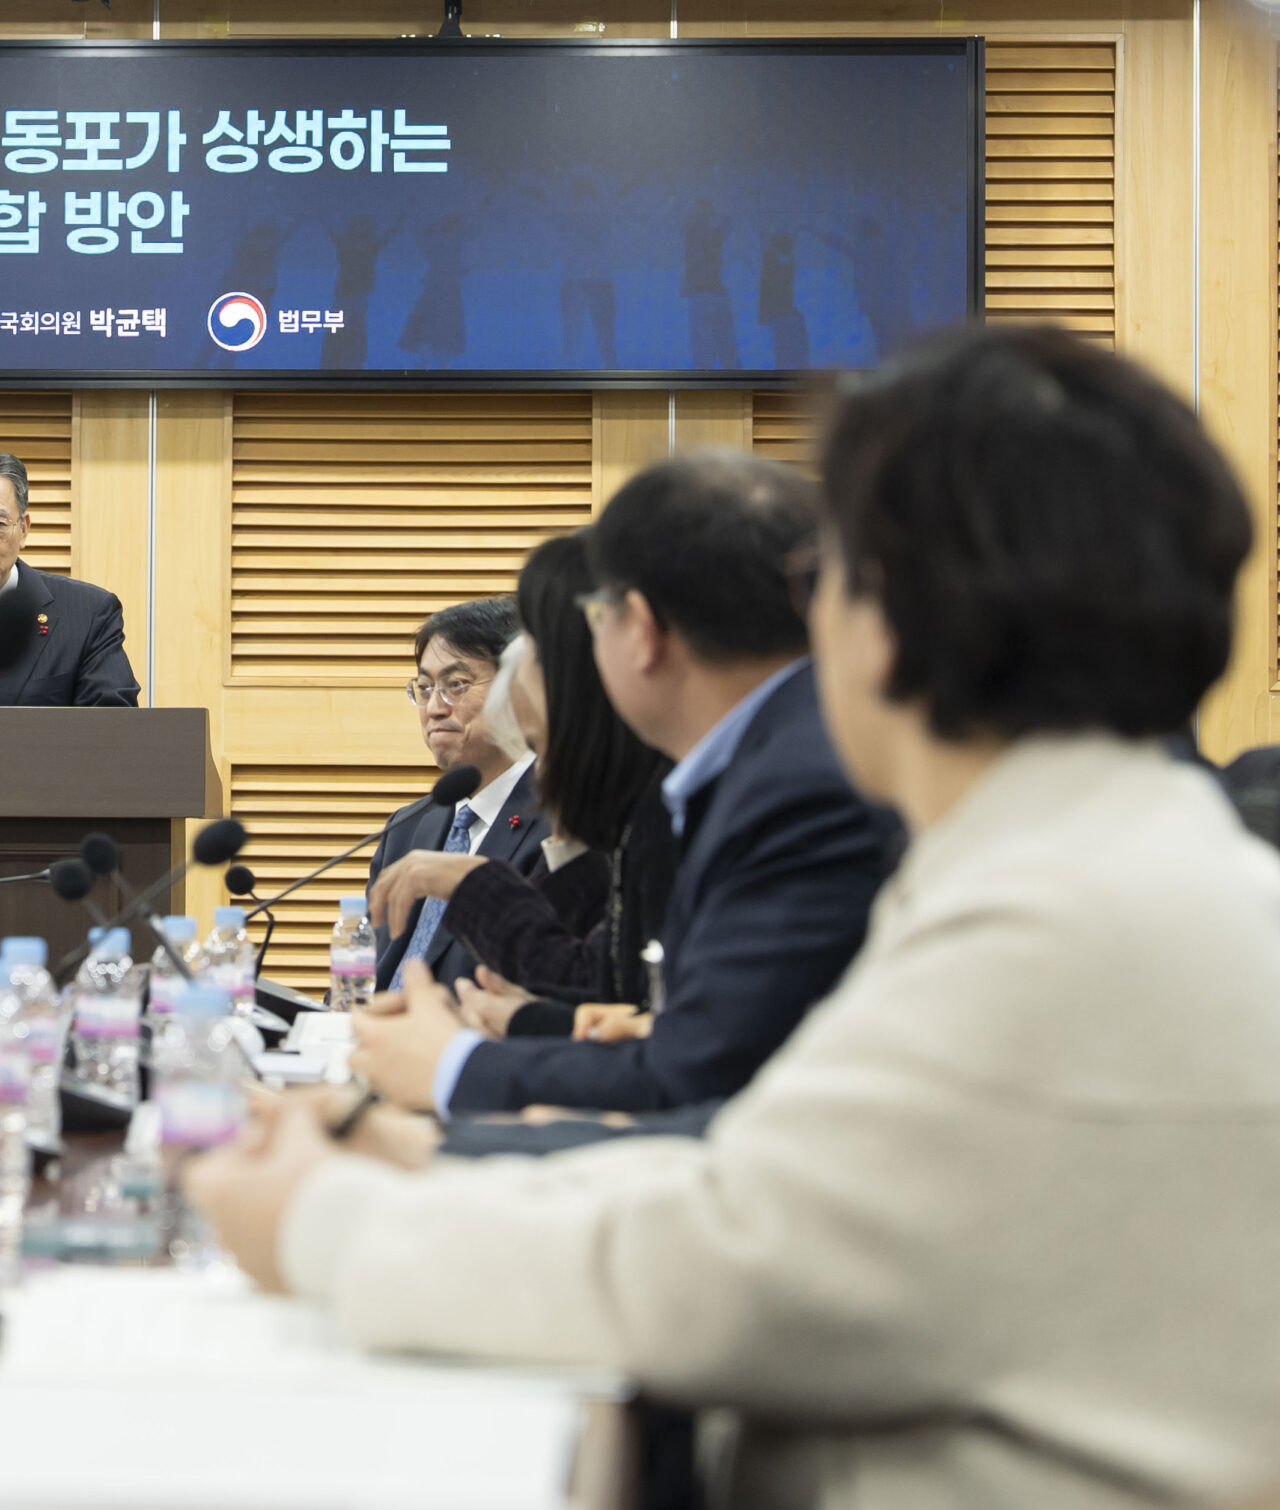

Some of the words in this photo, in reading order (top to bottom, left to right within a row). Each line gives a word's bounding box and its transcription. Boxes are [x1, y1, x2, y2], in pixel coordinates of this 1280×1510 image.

[1, 109, 188, 174] 동포가
[201, 109, 452, 174] 상생하는
[64, 190, 191, 255] 방안
[89, 307, 167, 338] 박균택
[278, 309, 345, 334] 법무부
